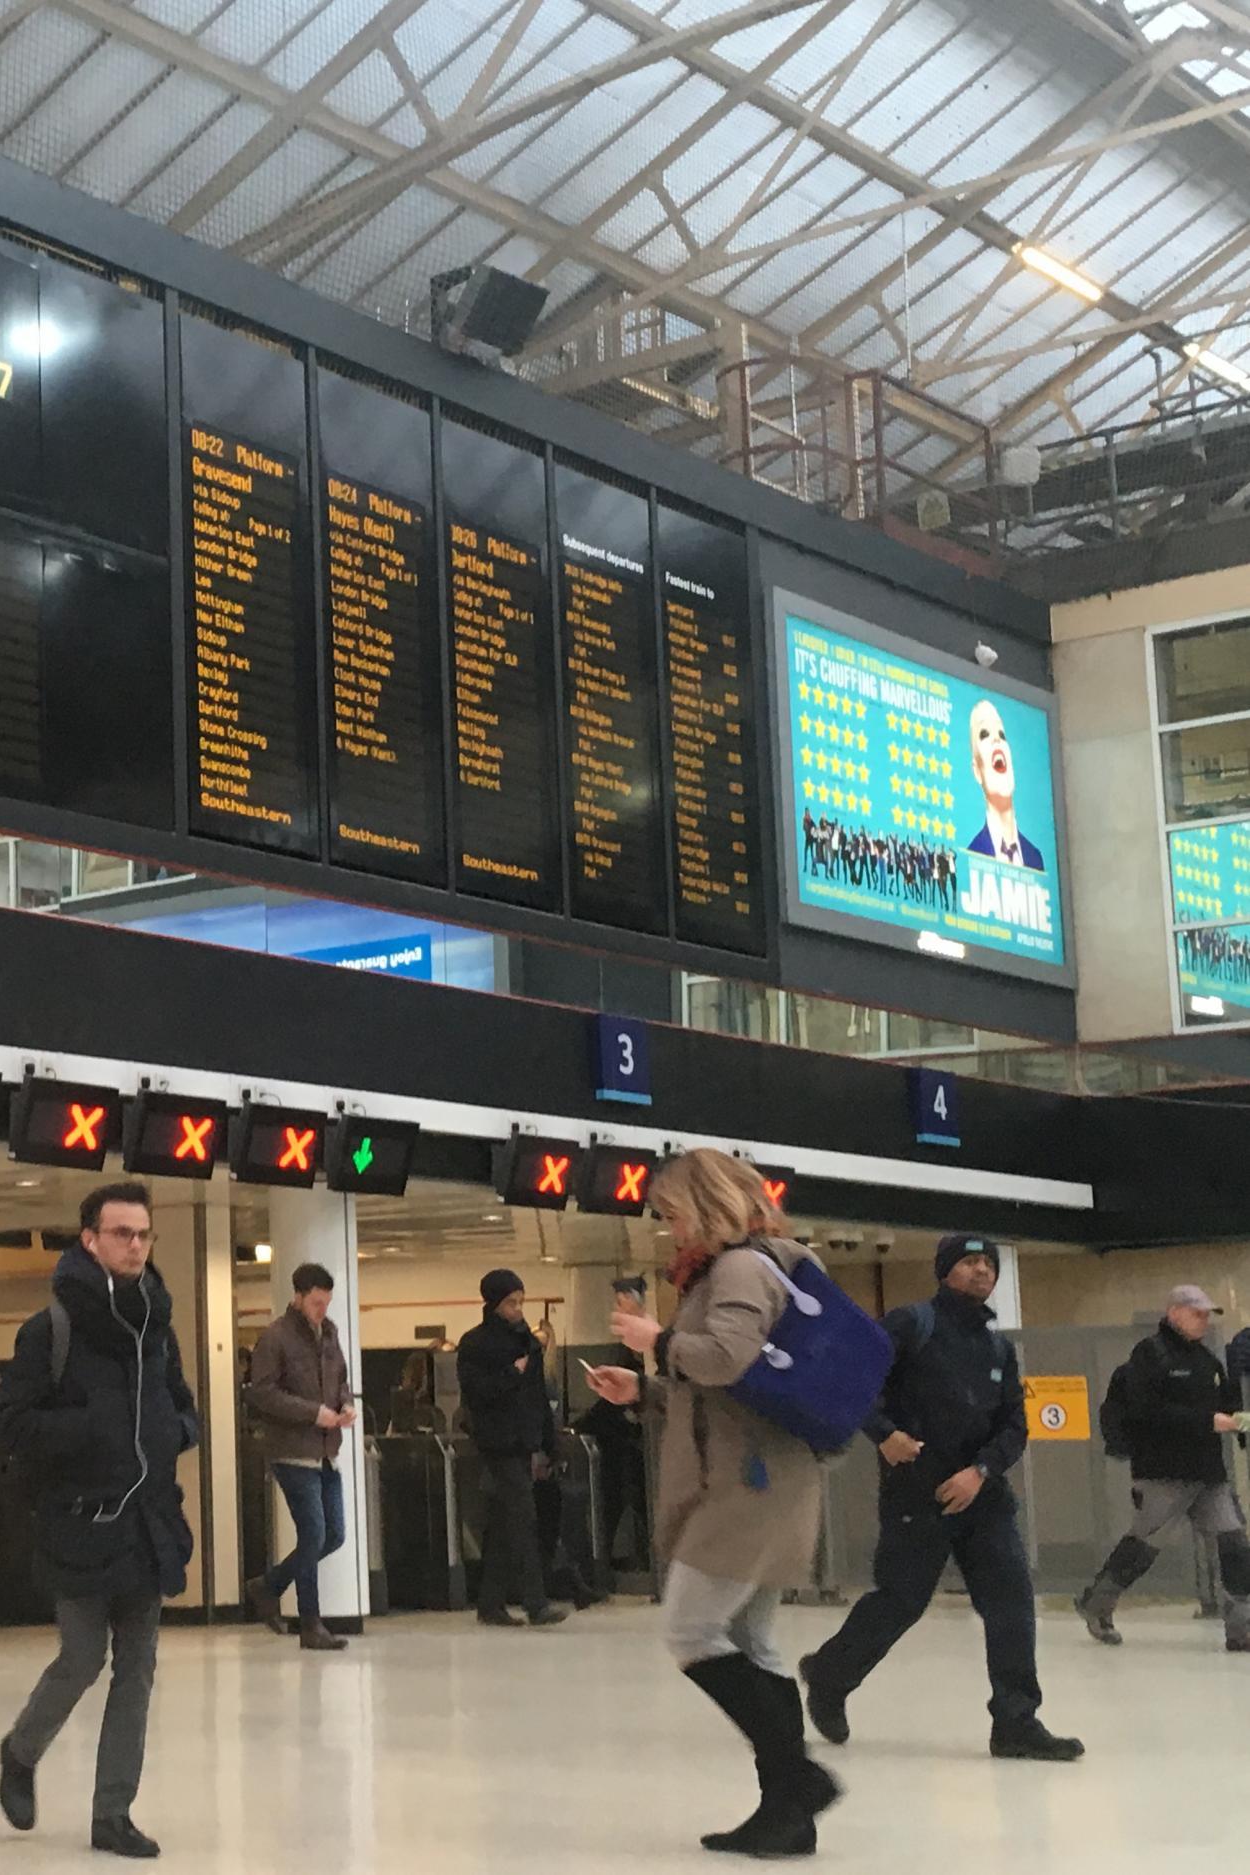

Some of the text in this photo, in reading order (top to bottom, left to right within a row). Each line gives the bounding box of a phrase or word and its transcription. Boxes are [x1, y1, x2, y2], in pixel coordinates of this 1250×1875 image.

[193, 456, 252, 493] Gravesend
[237, 445, 283, 478] Platform
[329, 504, 359, 530] Hayes
[194, 535, 258, 568] London Bridge
[563, 533, 644, 574] Subsequent departures
[195, 553, 253, 582] Hither Green
[195, 571, 212, 588] Lee
[666, 571, 715, 600] Fastest train to
[196, 590, 244, 615] Mottingham
[197, 626, 227, 648] Sidcup
[215, 613, 245, 633] Eltham
[197, 644, 250, 672] Albany Park
[198, 662, 228, 685] Bexley
[820, 656, 878, 700] CHUFFING
[198, 681, 238, 704] Crayford
[199, 699, 238, 722] Dartford
[199, 718, 267, 750] Stone Crossing
[199, 737, 249, 761] Greenhithe
[200, 755, 251, 779] Swanscombe
[200, 773, 248, 797] Northfleet
[201, 792, 291, 824] Southeastern
[339, 824, 420, 855] Southeastern
[463, 853, 538, 881] Southeastern
[960, 869, 1052, 934] JAMIE
[618, 1033, 634, 1075] 3
[934, 1085, 947, 1120] 4
[1048, 1407, 1060, 1426] 3
